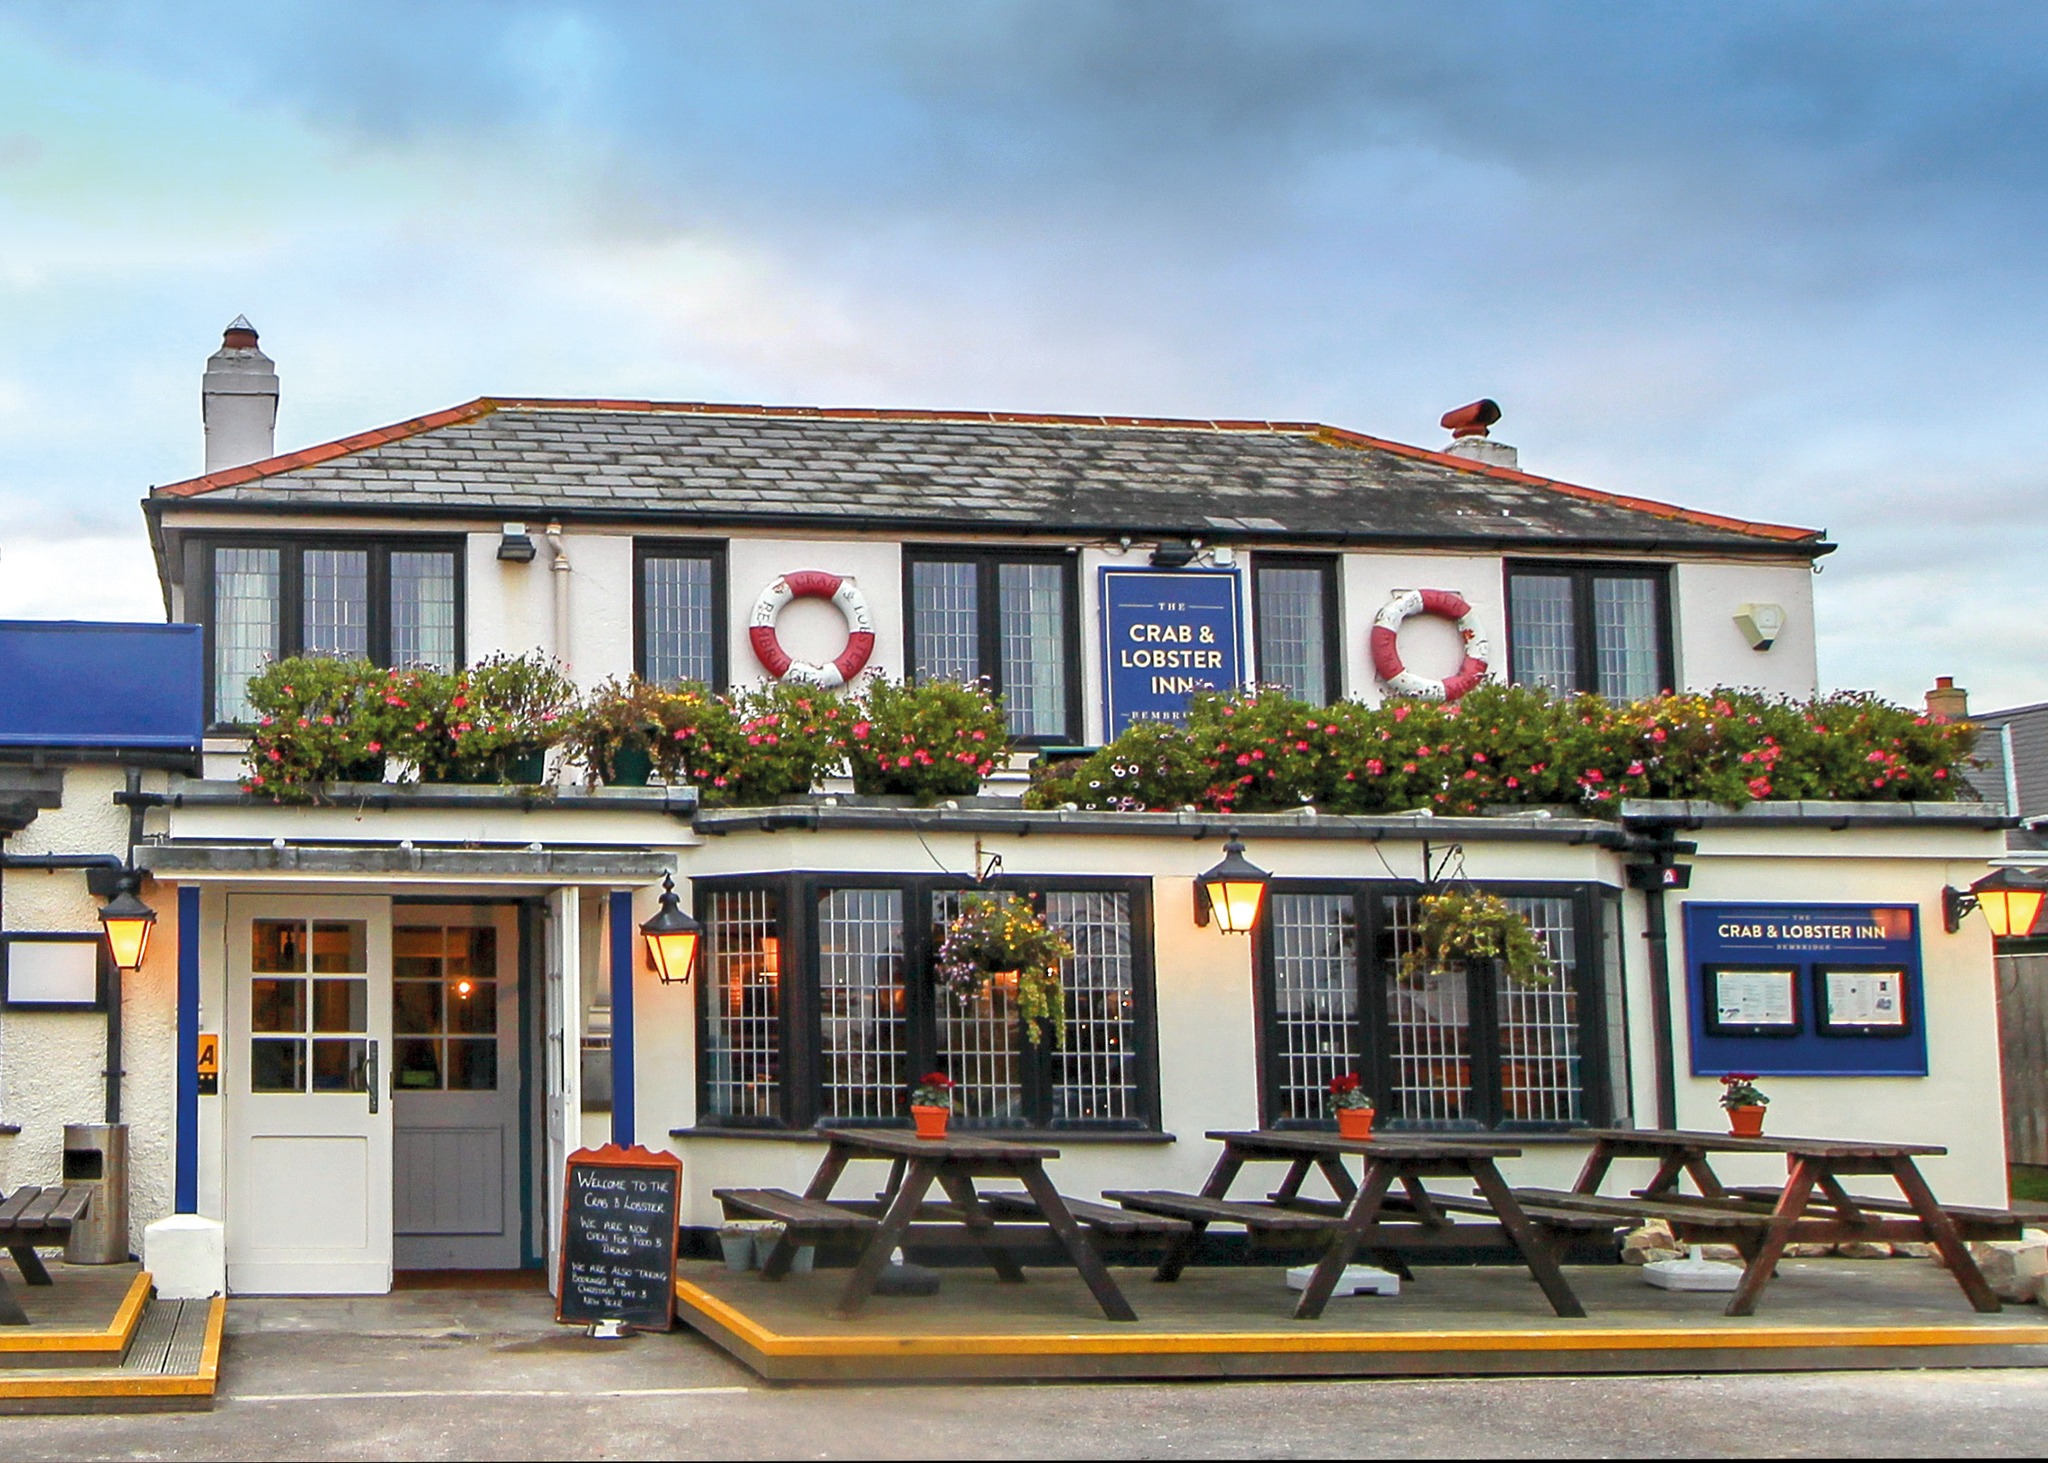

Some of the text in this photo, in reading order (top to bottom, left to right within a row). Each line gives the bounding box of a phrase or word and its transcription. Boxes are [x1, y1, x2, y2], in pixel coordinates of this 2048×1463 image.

[1157, 602, 1186, 612] THE
[795, 573, 841, 590] CRAB
[841, 604, 872, 672] LOBSTER
[1129, 624, 1215, 644] CRAB &
[1121, 649, 1222, 668] LOBSTER
[1151, 676, 1194, 695] INN
[1718, 924, 1886, 939] CRAB & LOBSTER INN
[198, 1044, 214, 1066] A
[577, 1171, 668, 1193] WELCOME TO THE
[584, 1192, 608, 1208] CRAB
[624, 1195, 664, 1213] LOBSTER
[580, 1216, 648, 1234] WE ARE NOW
[586, 1231, 608, 1242] OPEN
[613, 1234, 628, 1244] FOR
[633, 1234, 652, 1247] FOOD
[571, 1262, 585, 1271] WE
[589, 1264, 606, 1274] ARE
[611, 1266, 632, 1277] ALSO
[613, 1278, 626, 1287] FOR
[583, 1296, 622, 1308] NEW YEAR
[621, 1289, 636, 1298] DAY
